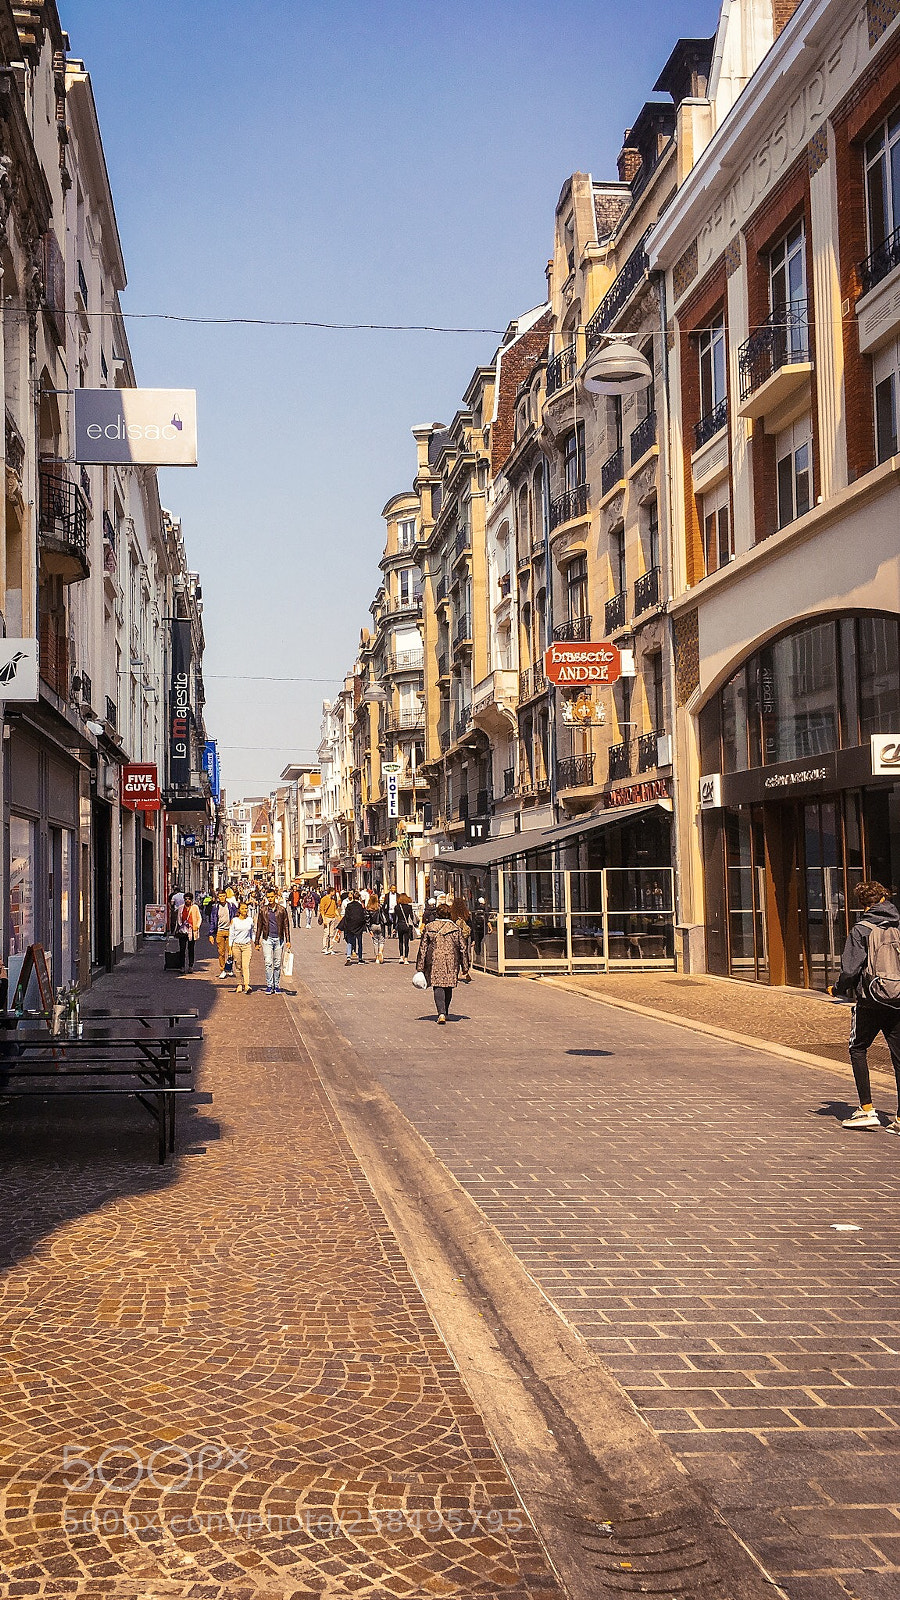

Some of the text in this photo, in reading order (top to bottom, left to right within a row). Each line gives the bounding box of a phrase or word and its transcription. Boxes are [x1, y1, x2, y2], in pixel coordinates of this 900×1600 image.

[86, 414, 178, 441] edisac
[551, 647, 614, 664] brasserie
[172, 672, 190, 759] Le majestic
[127, 774, 153, 783] FIVE
[125, 783, 156, 792] GUYS
[389, 776, 397, 816] HOTEL
[470, 824, 483, 838] IT
